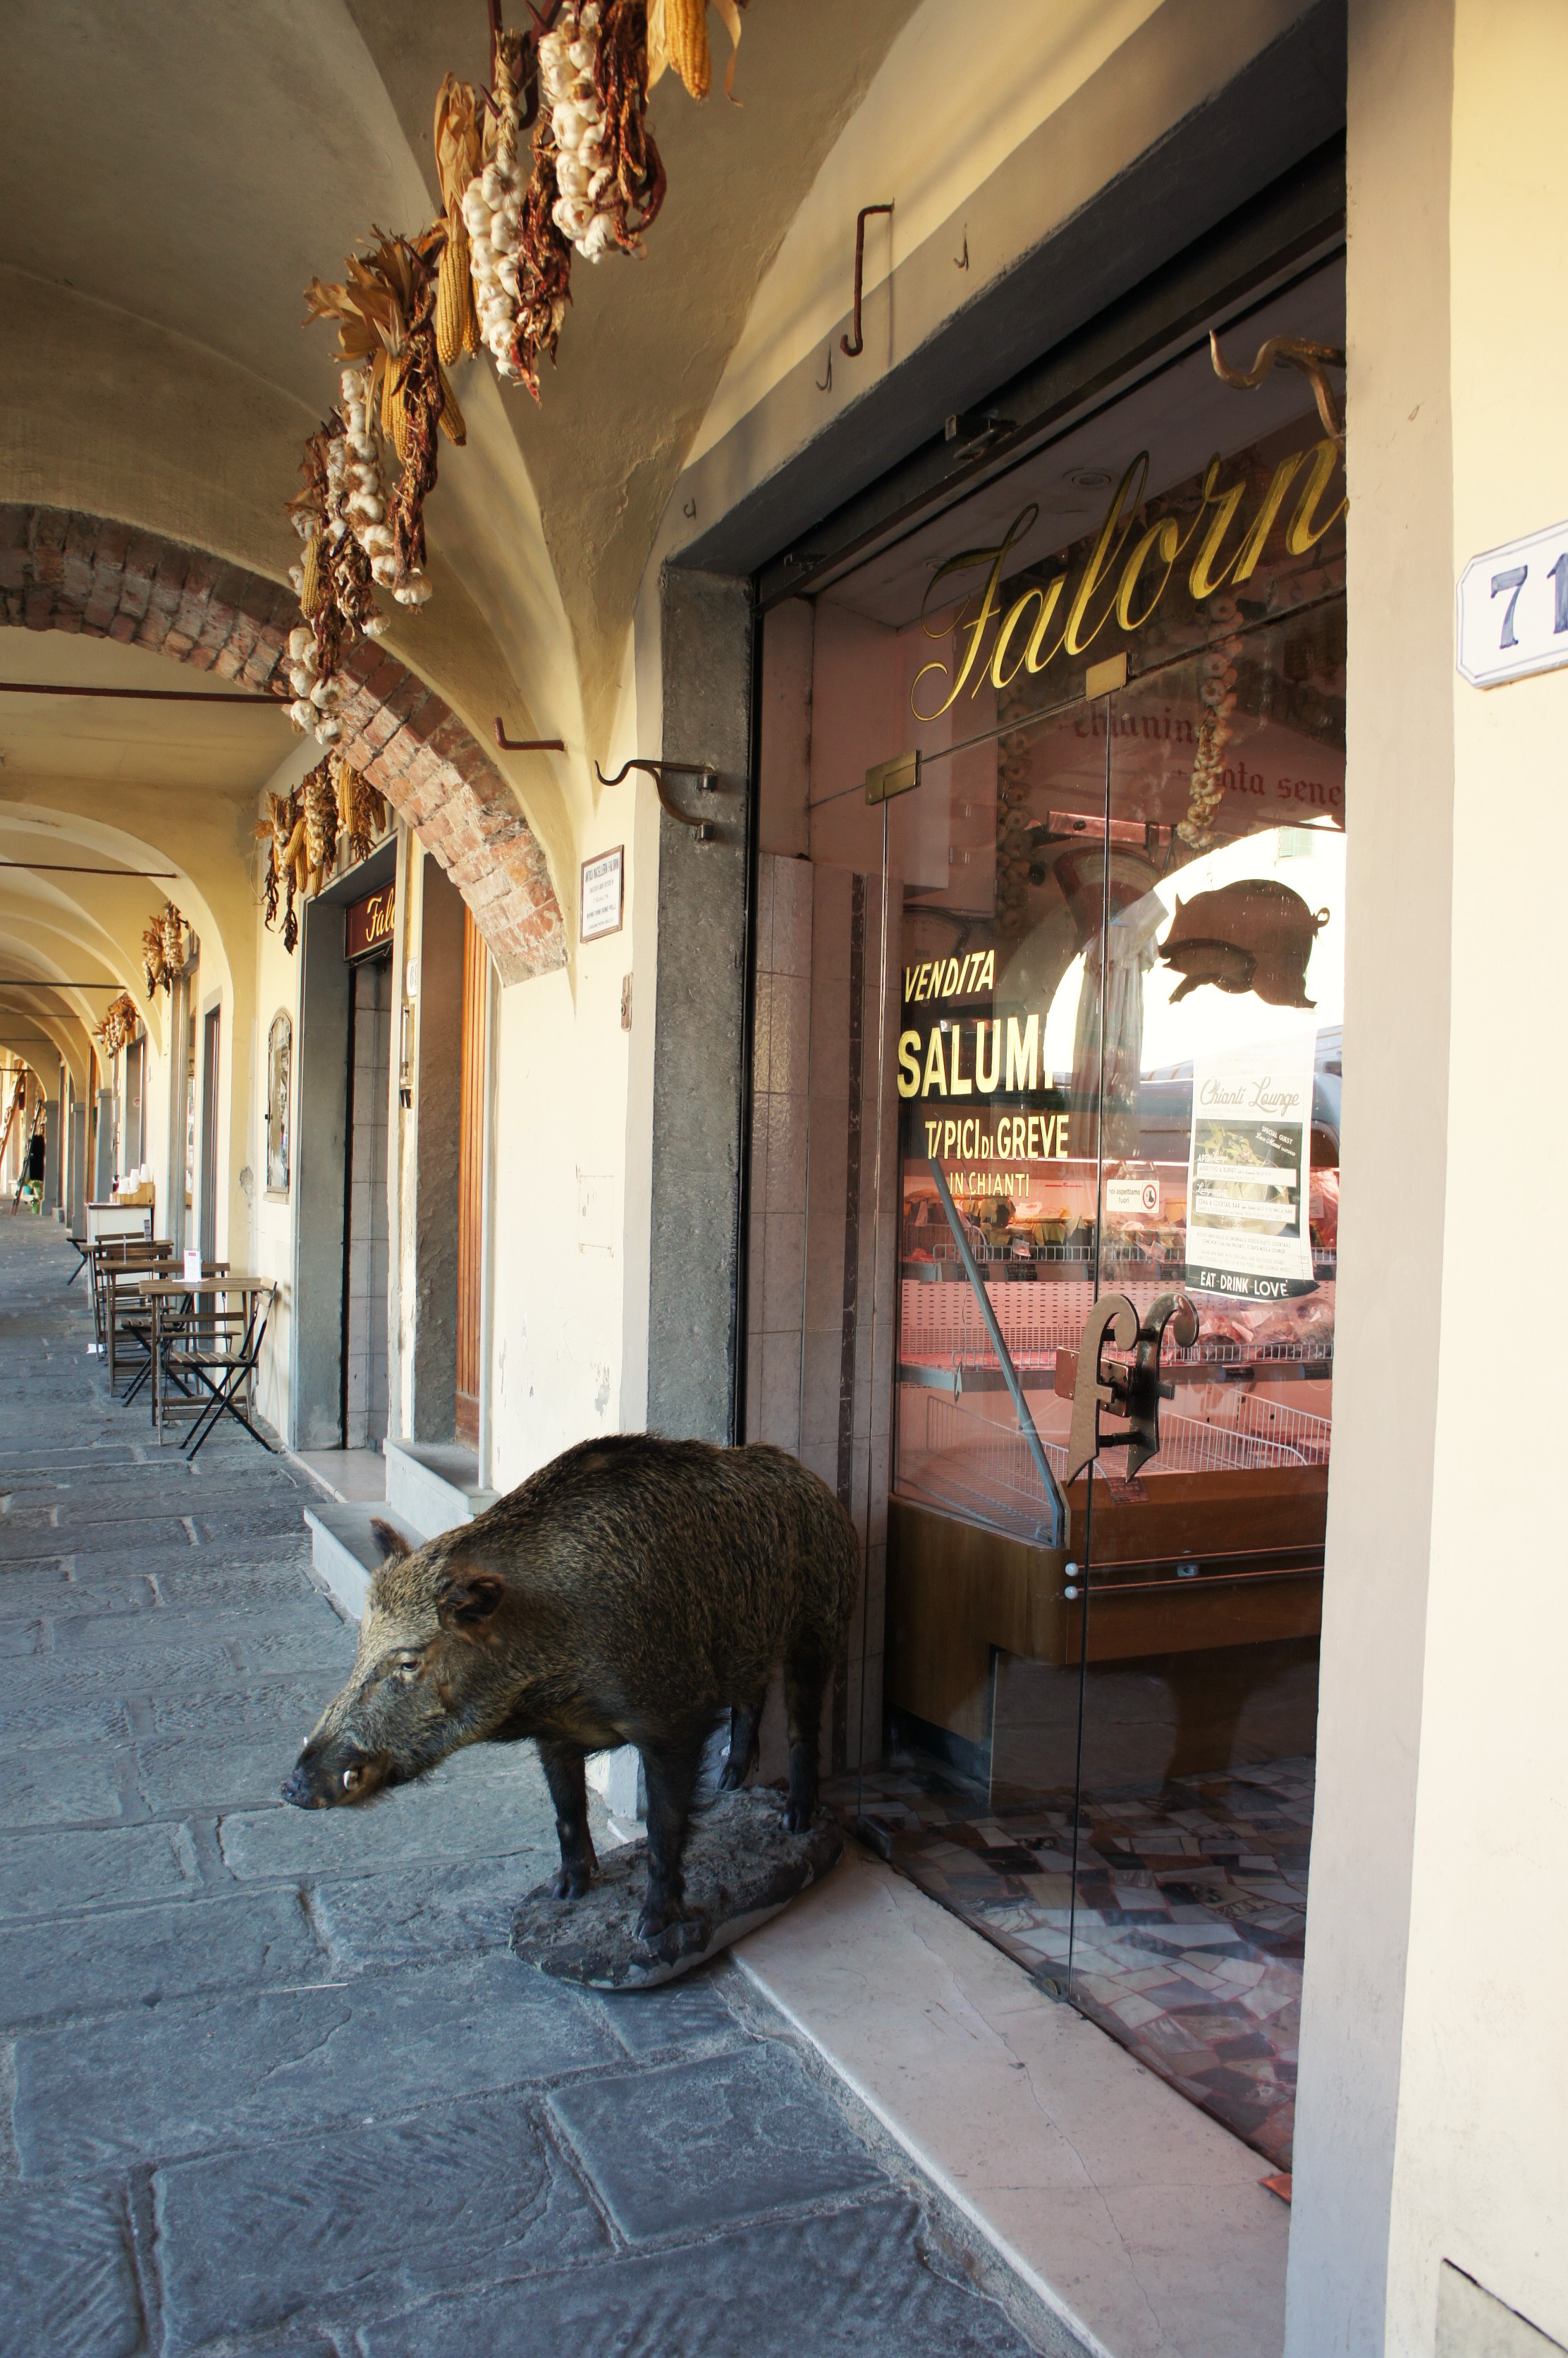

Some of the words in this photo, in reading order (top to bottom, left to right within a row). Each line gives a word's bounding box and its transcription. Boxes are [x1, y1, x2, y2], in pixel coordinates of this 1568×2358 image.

[1490, 552, 1568, 649] 71
[1074, 704, 1199, 745] chianin
[905, 949, 995, 1003] VENDITA
[897, 1014, 1054, 1098] SALUM
[1200, 1077, 1247, 1106] Chianti
[1248, 1076, 1300, 1118] Lounge
[981, 1135, 993, 1157] DI
[996, 1115, 1070, 1160] GREVE
[1261, 1125, 1278, 1139] SPECIAL
[1278, 1134, 1293, 1145] GUEST
[949, 1172, 964, 1195] IN
[969, 1171, 1029, 1197] CHIANTI
[1116, 1188, 1141, 1197] aspettiamo
[1200, 1271, 1216, 1288] EAT
[1220, 1274, 1249, 1294] DRINK
